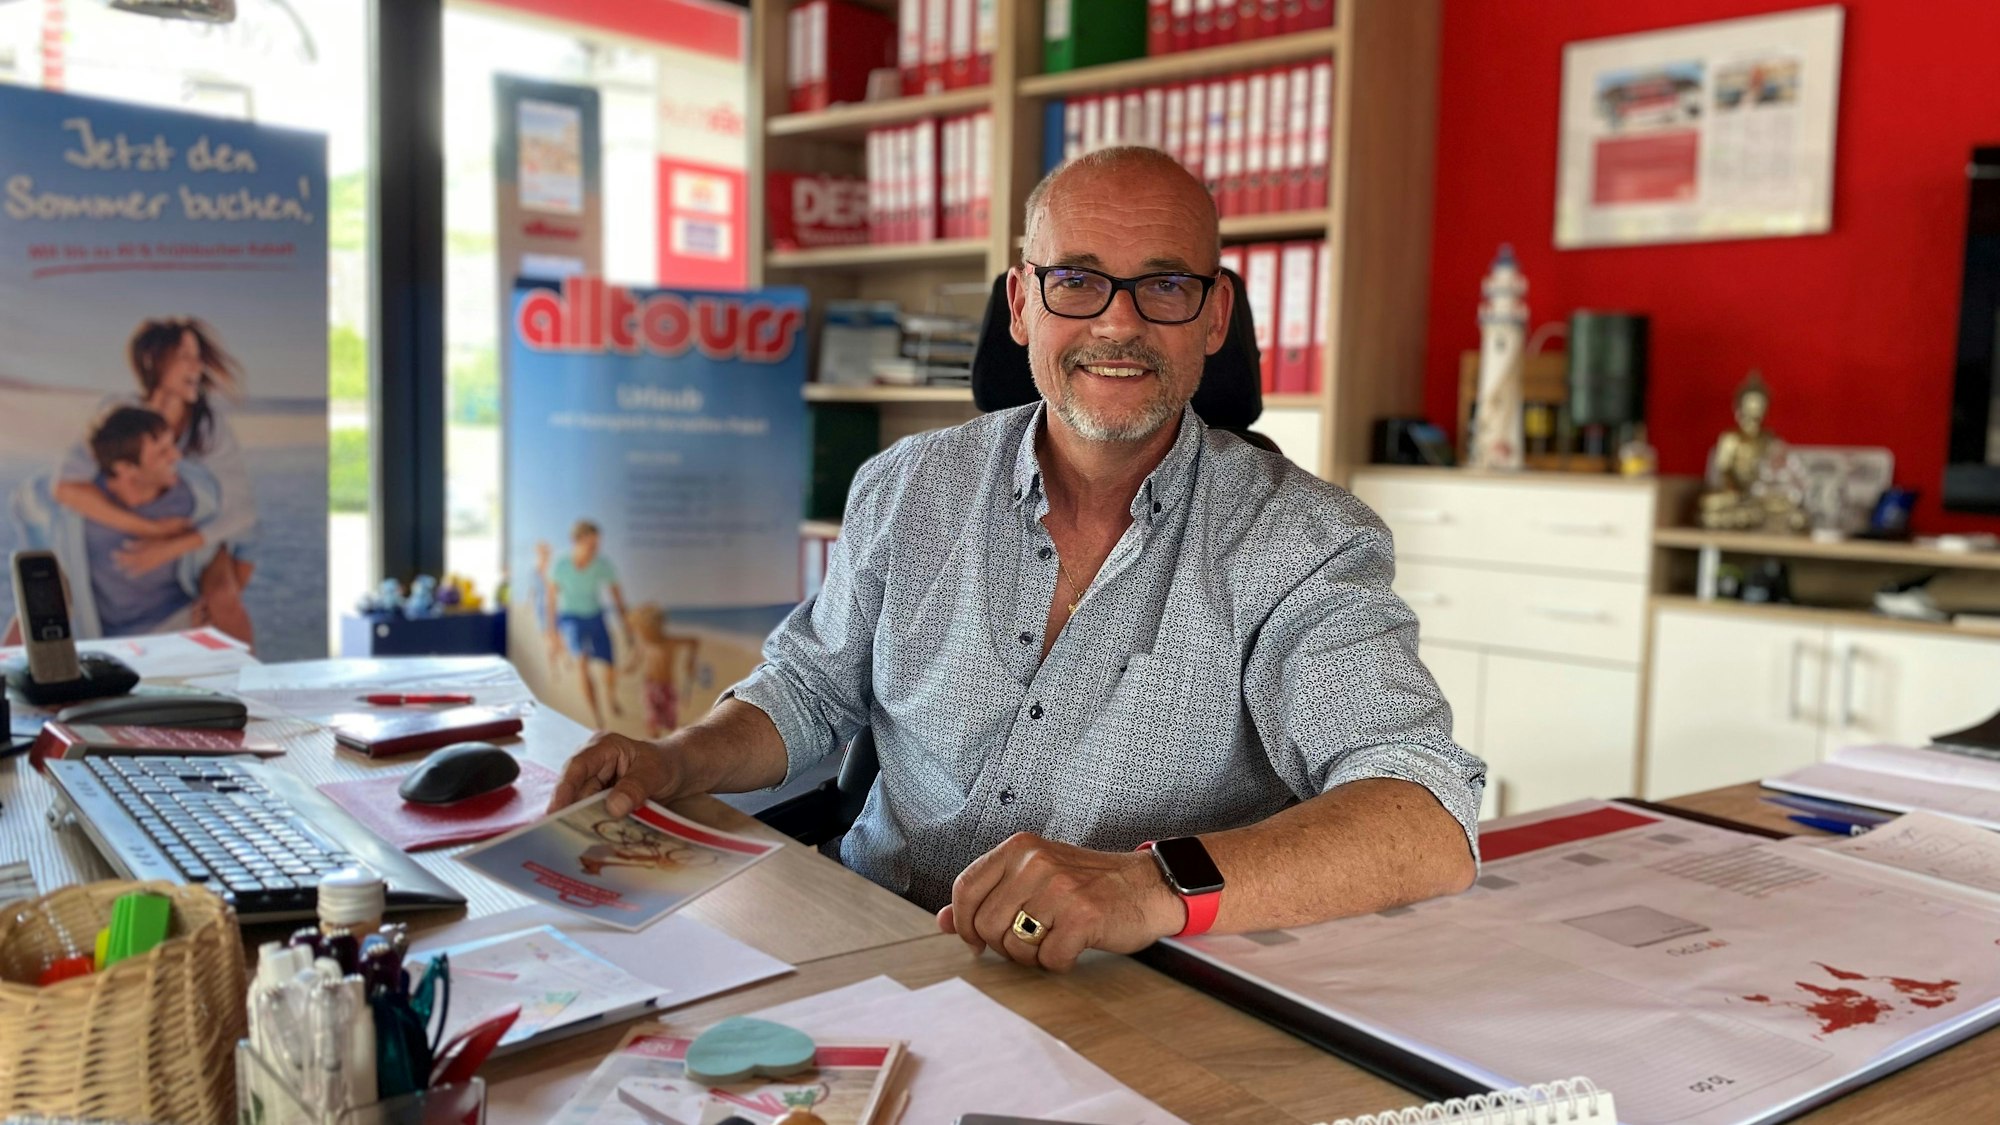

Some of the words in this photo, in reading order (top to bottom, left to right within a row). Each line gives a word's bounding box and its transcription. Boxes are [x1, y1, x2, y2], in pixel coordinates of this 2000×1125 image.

[63, 117, 176, 170] Jetzt
[186, 136, 257, 173] den
[5, 175, 170, 220] Sommer
[178, 175, 315, 224] buchen!
[518, 274, 803, 363] alltours
